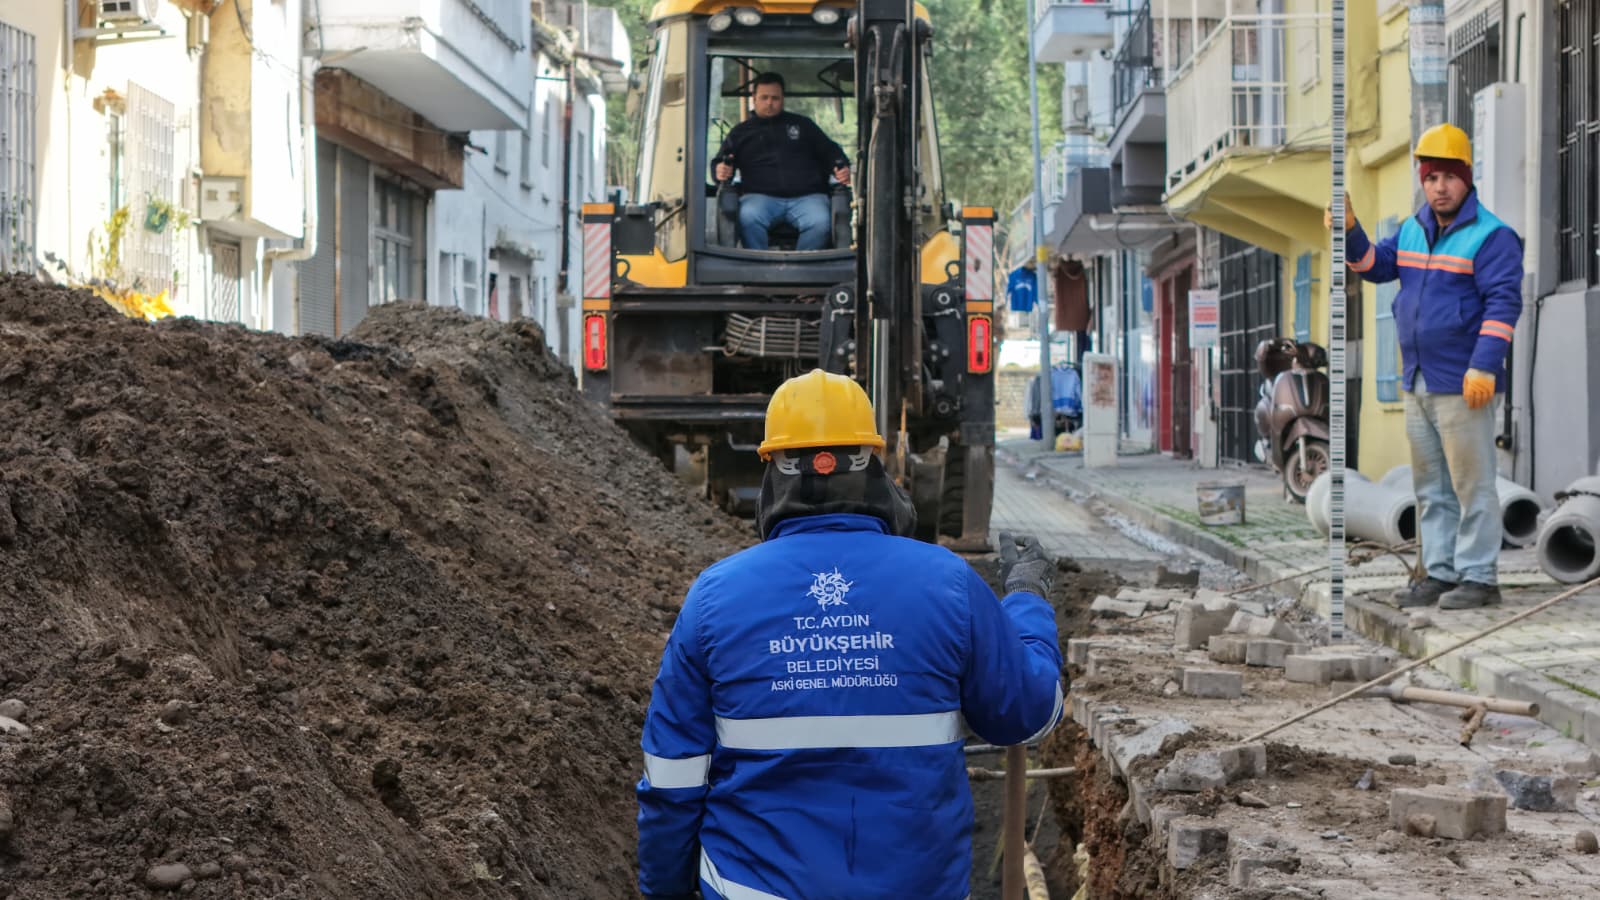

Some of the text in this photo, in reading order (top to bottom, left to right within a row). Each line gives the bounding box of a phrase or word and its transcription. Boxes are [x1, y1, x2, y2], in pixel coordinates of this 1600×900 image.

[769, 631, 895, 654] BÜYÜKŞEHİR
[786, 655, 879, 673] BELEDİYESİ
[771, 674, 898, 692] ASKİ GENEL MÜDÜRLÜĞÜ
